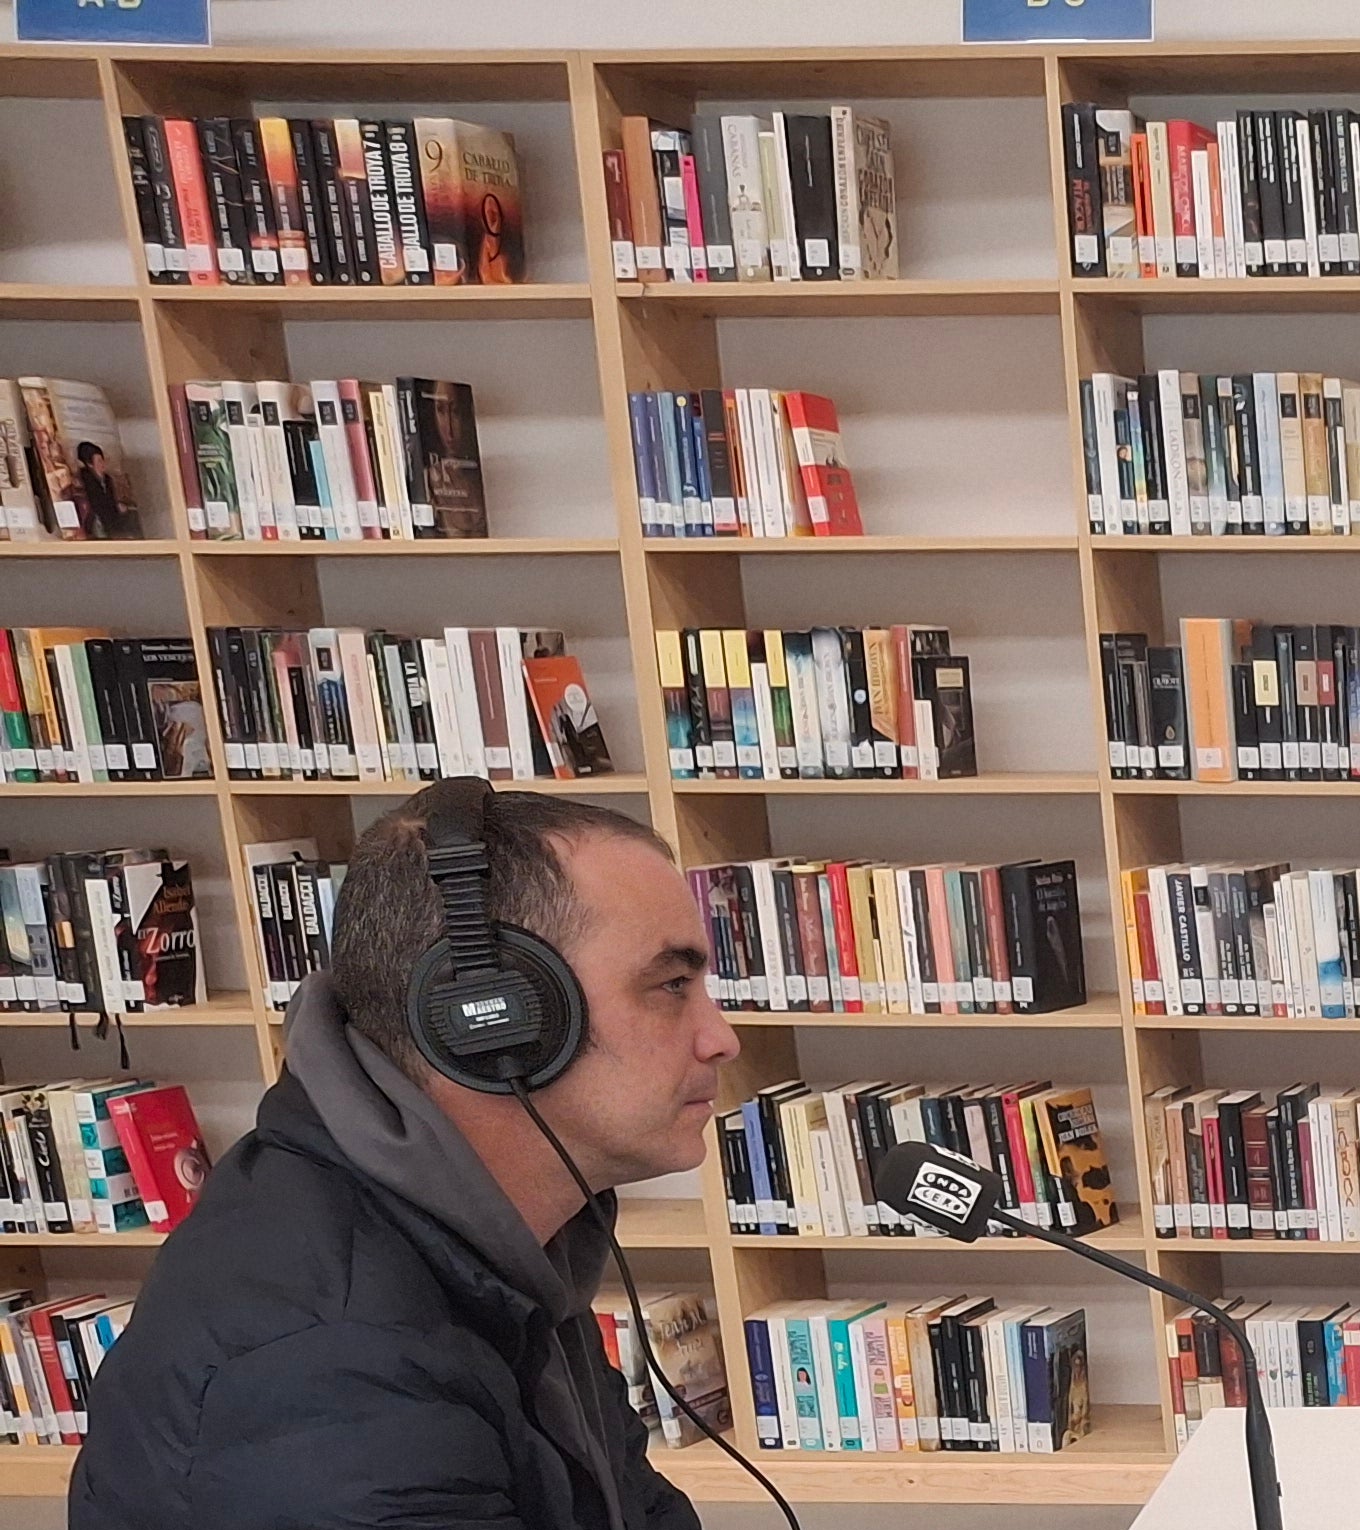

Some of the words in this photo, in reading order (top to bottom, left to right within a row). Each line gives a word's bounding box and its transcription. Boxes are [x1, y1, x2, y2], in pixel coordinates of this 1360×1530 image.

[366, 154, 386, 190] TROYA
[373, 209, 397, 268] CABALLO
[298, 875, 320, 935] BALDACCI
[1174, 880, 1186, 913] JAVIER
[146, 926, 197, 954] Zorro
[1179, 915, 1191, 962] CASTILLO
[922, 1189, 961, 1211] CERO
[926, 1173, 968, 1198] ONDA
